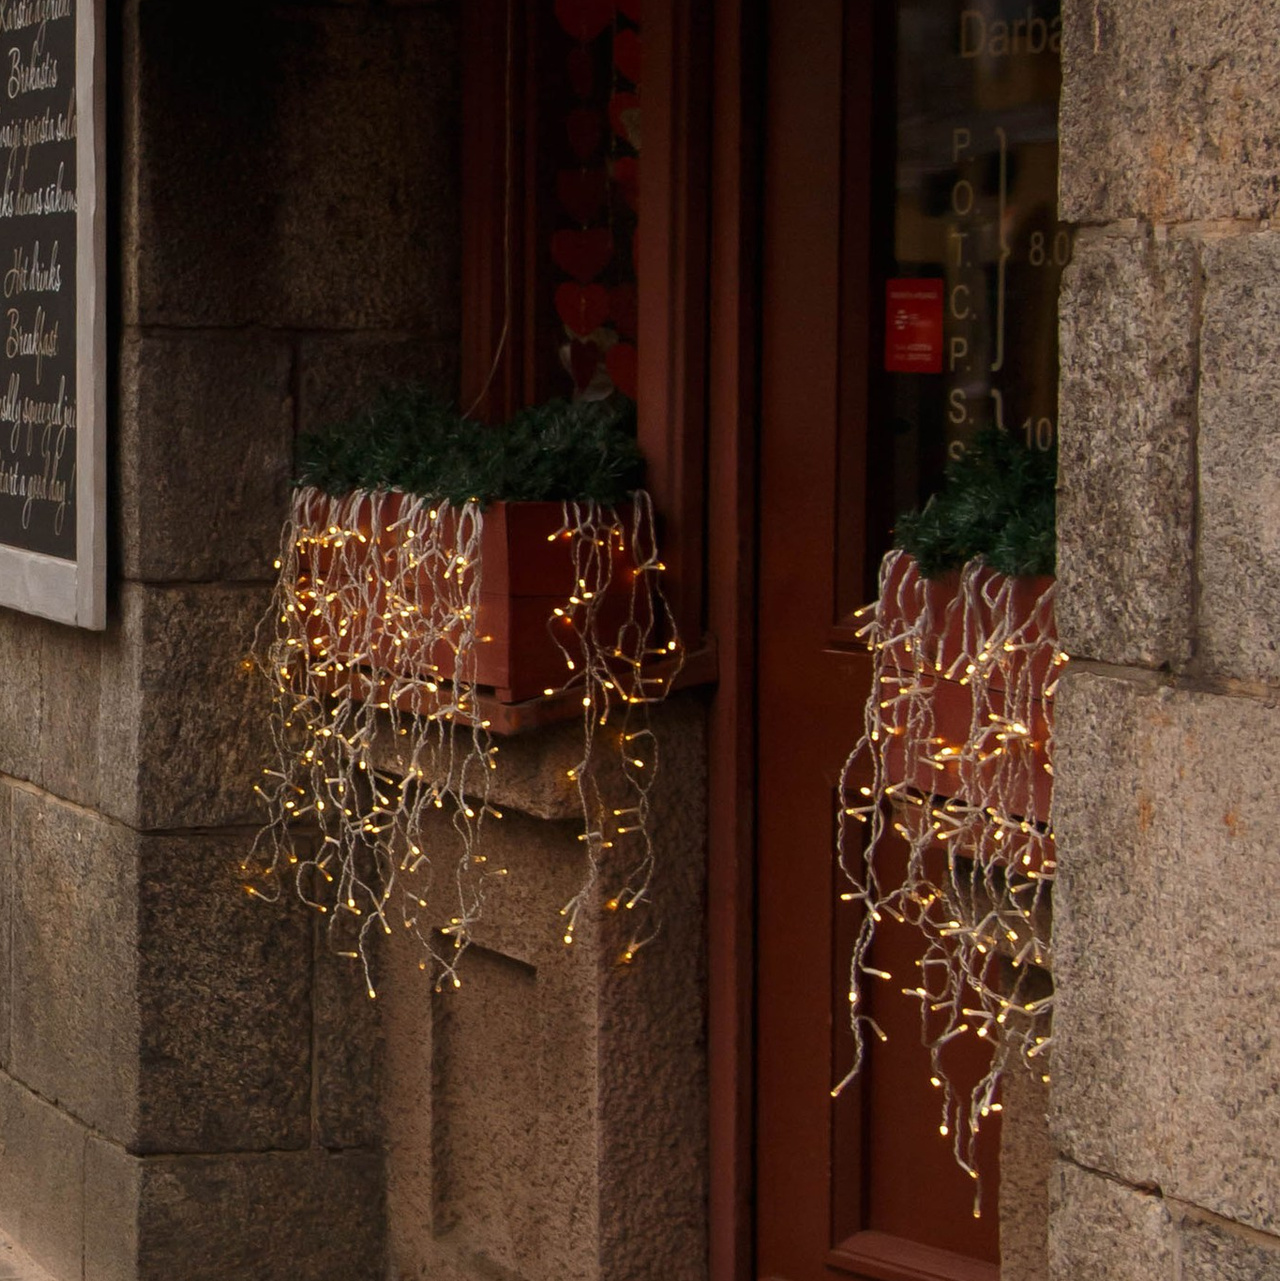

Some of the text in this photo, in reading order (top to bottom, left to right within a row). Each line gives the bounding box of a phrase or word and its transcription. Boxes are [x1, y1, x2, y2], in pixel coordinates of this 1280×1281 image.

[4, 240, 61, 298] Hot drinks
[6, 305, 59, 385] Breakfast
[19, 475, 26, 496] a
